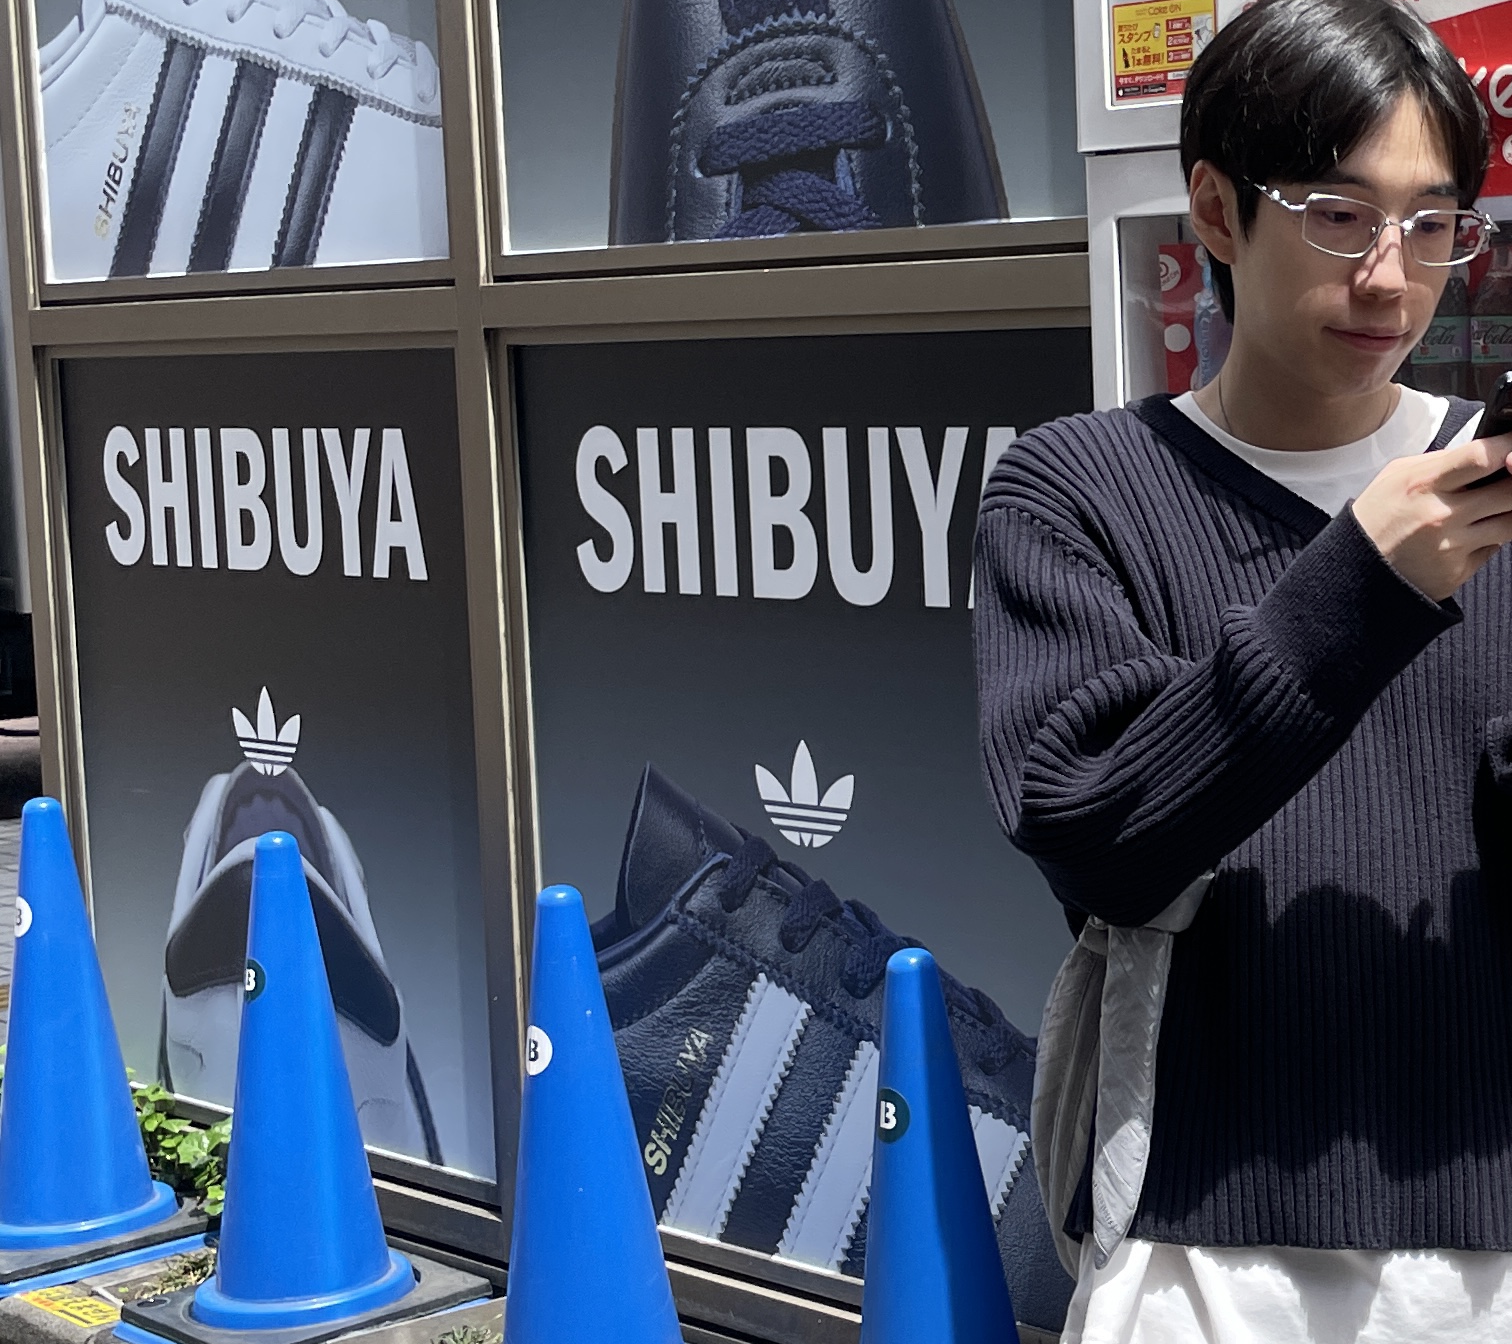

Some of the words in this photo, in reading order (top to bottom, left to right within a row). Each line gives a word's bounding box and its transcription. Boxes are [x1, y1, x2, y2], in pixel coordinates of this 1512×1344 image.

[1118, 30, 1151, 44] スタンプ
[102, 424, 428, 582] SHIBUYA
[574, 424, 1016, 608] SHIBUY
[529, 1039, 540, 1061] B
[644, 1027, 714, 1176] SHIBUYA
[879, 1100, 897, 1130] B
